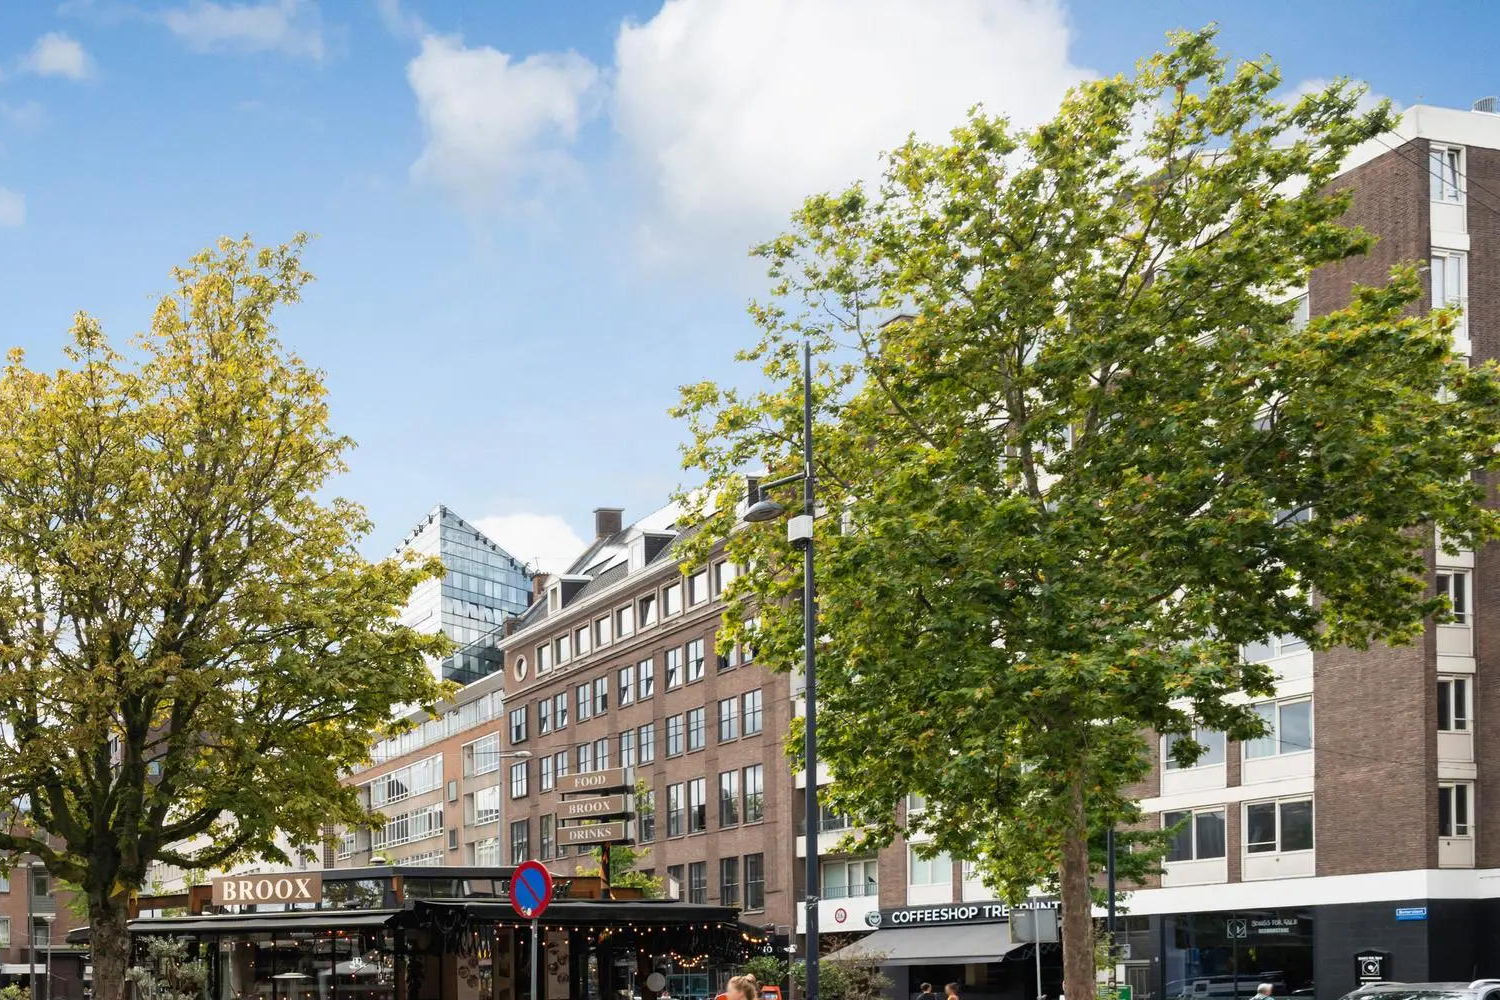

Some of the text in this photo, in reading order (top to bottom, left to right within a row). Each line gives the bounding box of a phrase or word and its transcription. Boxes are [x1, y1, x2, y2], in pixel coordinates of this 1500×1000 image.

[575, 775, 606, 788] FOOD
[569, 800, 610, 814] BROOX
[569, 827, 612, 841] DRINKS
[222, 878, 312, 901] BROOX
[891, 906, 979, 924] COFFEESHOP
